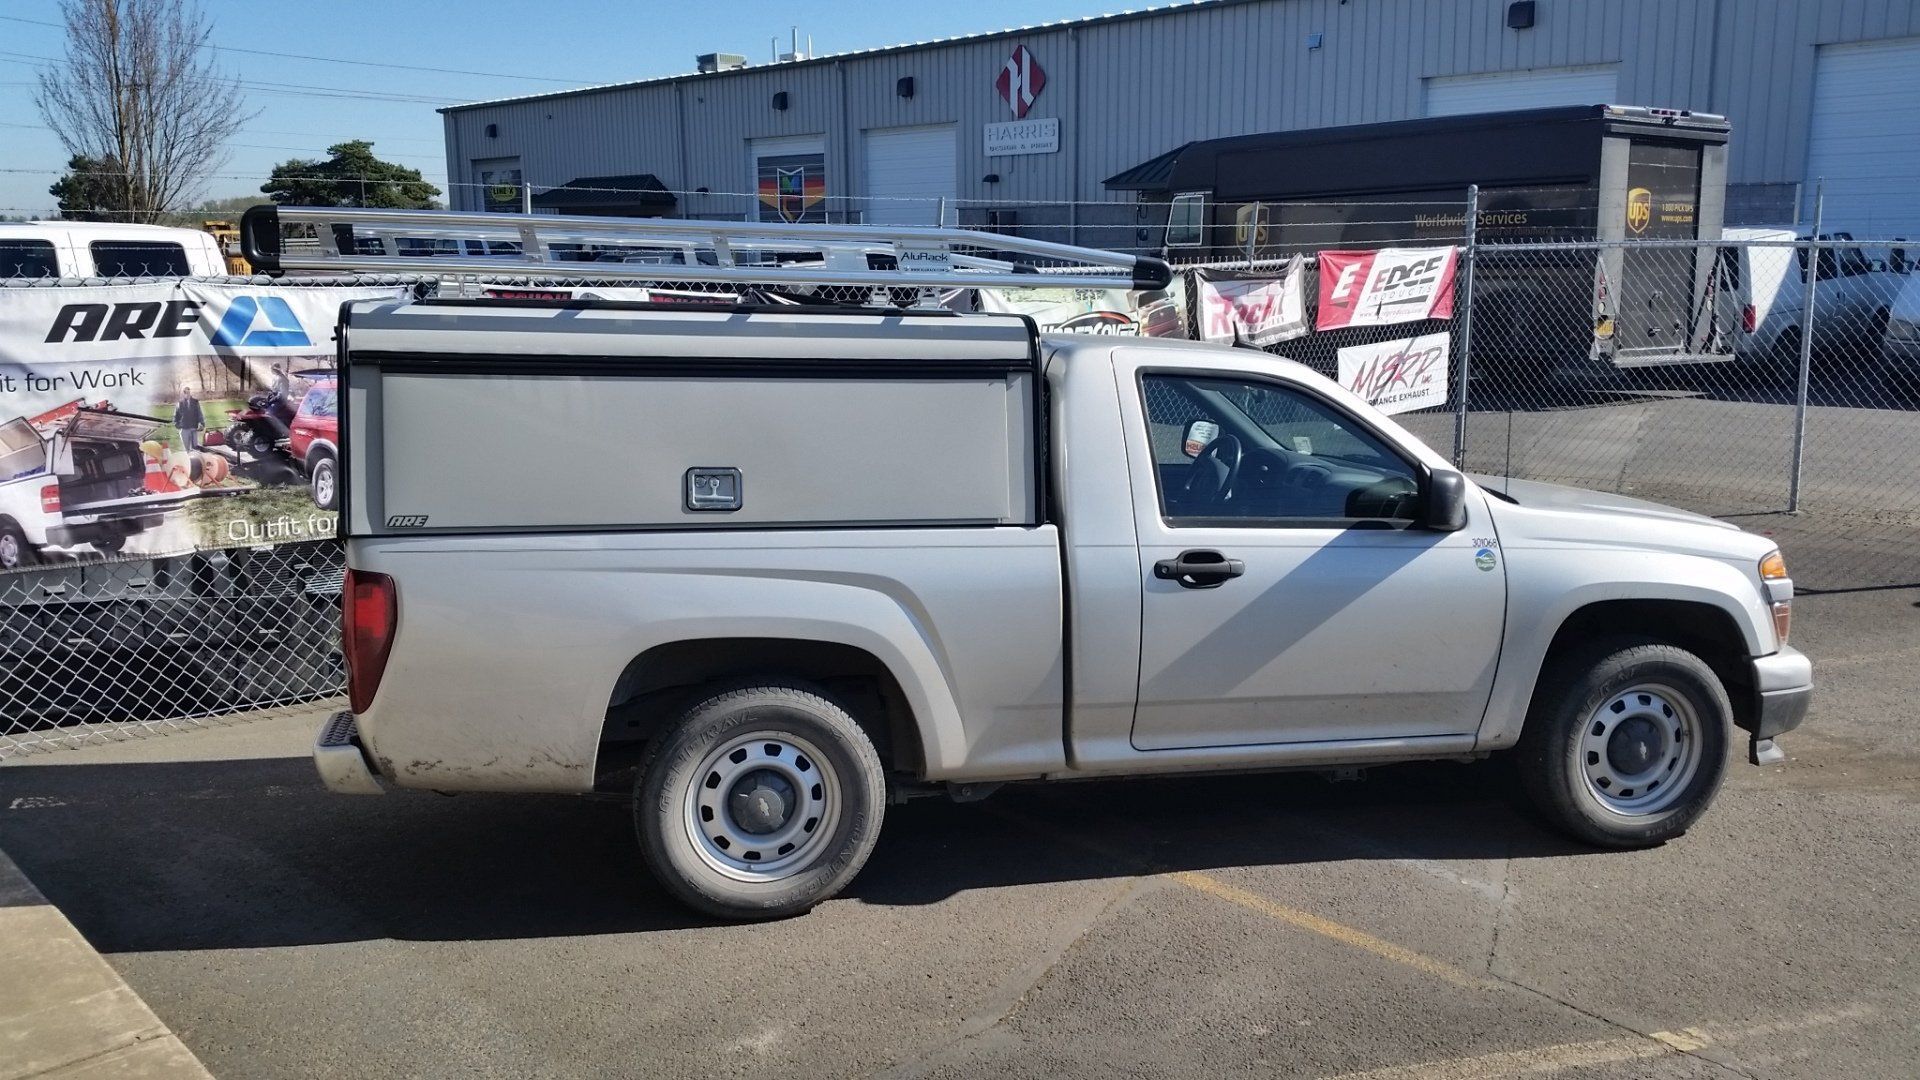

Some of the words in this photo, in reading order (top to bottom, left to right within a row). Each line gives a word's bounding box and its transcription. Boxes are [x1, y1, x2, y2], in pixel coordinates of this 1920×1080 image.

[988, 123, 1056, 142] HARRIS
[1478, 212, 1527, 225] Services
[901, 252, 948, 262] AluRack
[1370, 255, 1444, 293] EDGE
[1366, 284, 1433, 302] PRODUCTS
[44, 300, 207, 344] ARE
[1350, 338, 1443, 400] MBRP
[25, 372, 65, 392] for
[69, 366, 145, 390] Work
[1399, 388, 1430, 401] EXHAUST
[229, 515, 301, 541] Outfit
[387, 514, 429, 528] ARE
